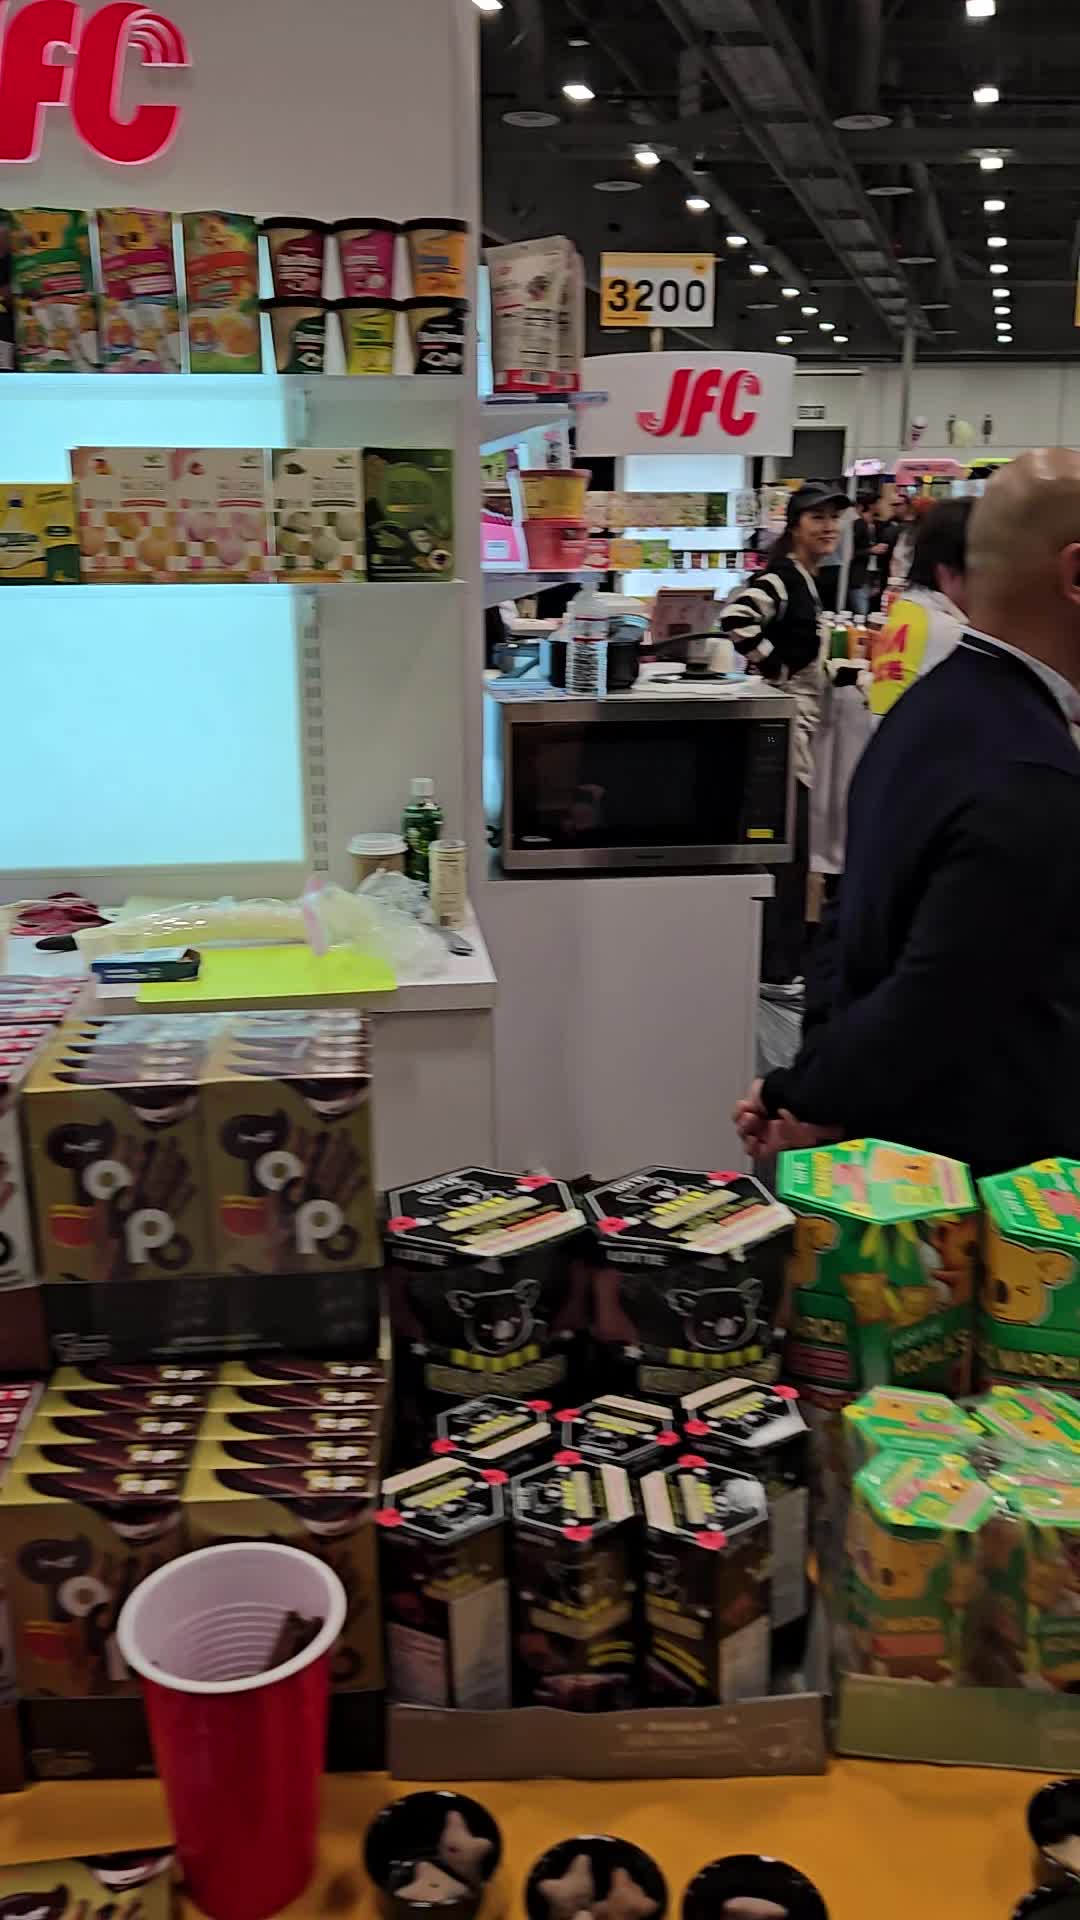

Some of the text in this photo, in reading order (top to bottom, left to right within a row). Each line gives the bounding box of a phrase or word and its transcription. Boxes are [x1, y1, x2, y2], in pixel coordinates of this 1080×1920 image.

[0, 0, 191, 165] FC
[608, 279, 706, 313] 3200
[635, 368, 762, 437] JFC
